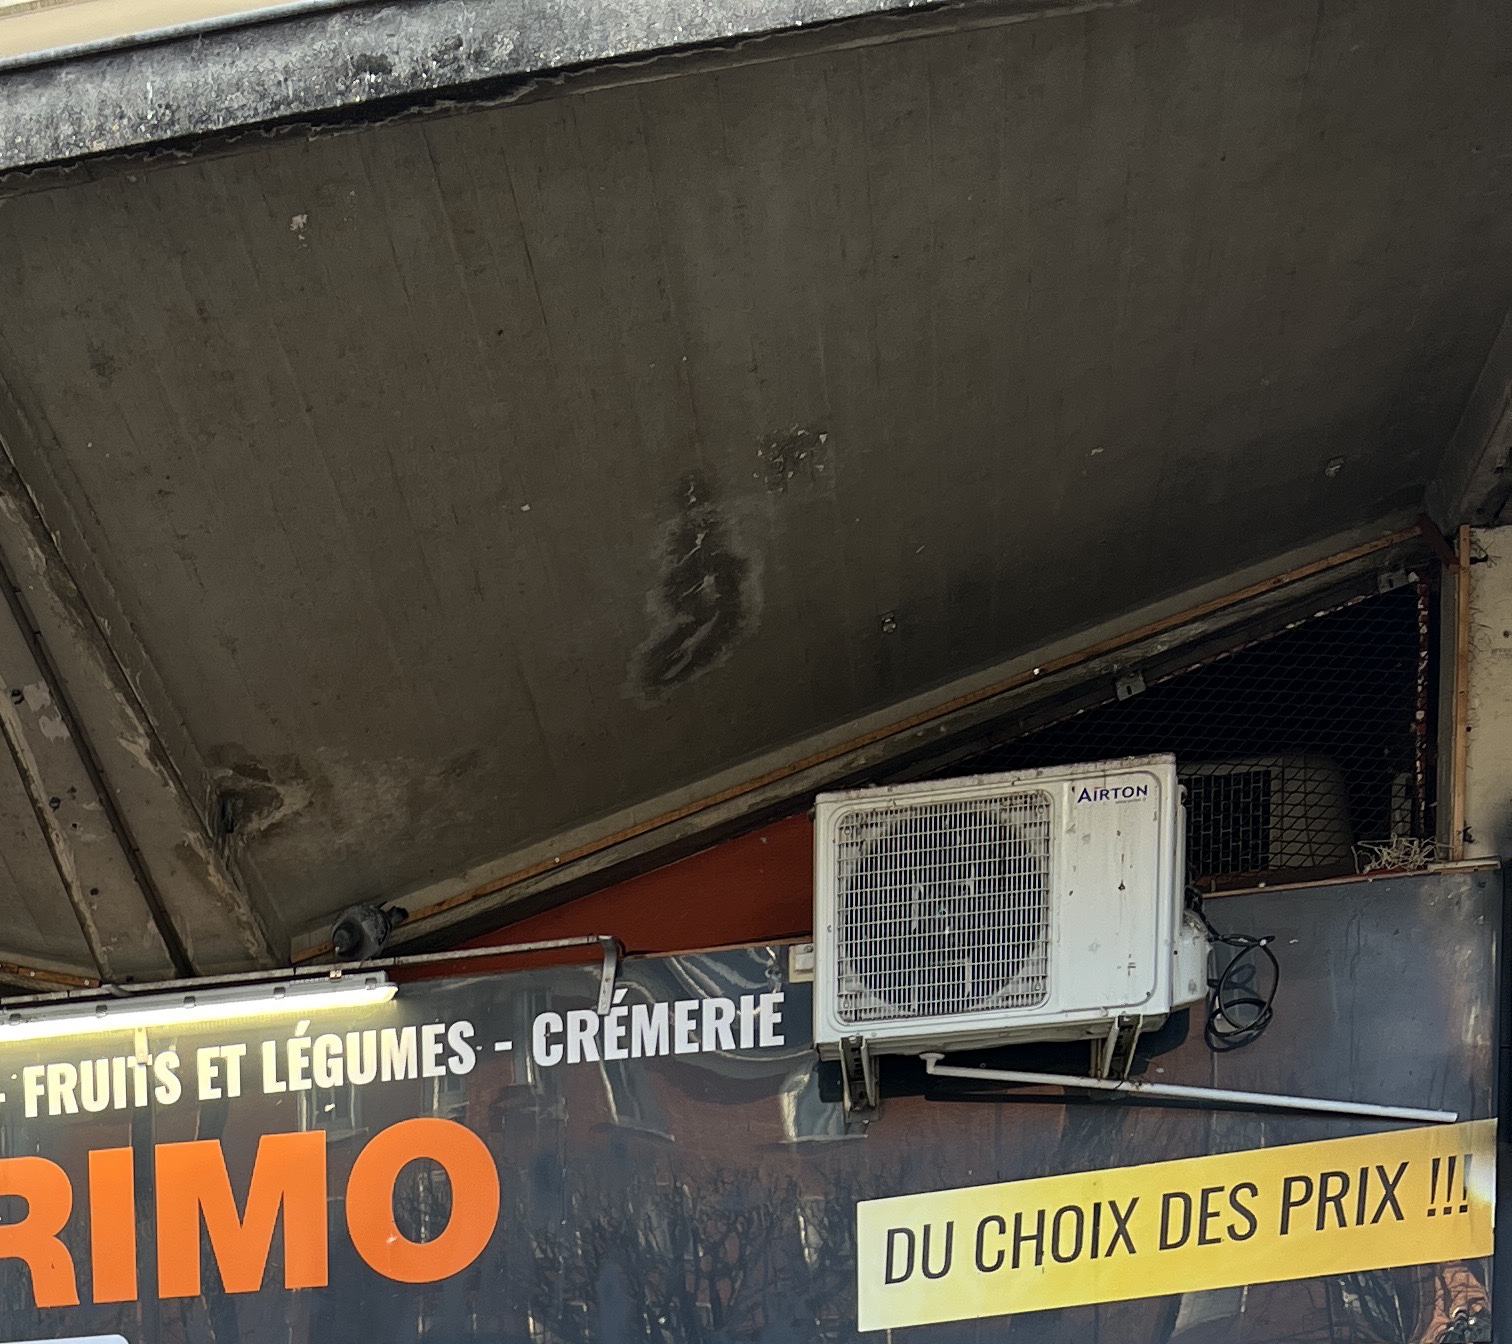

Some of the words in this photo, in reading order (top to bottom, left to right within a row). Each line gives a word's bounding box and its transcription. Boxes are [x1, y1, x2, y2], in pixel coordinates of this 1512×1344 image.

[1077, 784, 1148, 803] AIRTON
[24, 1050, 182, 1118] FRUITS
[197, 1044, 248, 1101] ET
[261, 1020, 477, 1093] LÉGUMES
[532, 988, 785, 1067] CRÉMERIE
[883, 1221, 955, 1286] DU
[974, 1196, 1141, 1274] CHOIX
[1158, 1181, 1259, 1252] DES
[1278, 1160, 1410, 1237] PRIX
[1426, 1152, 1473, 1218] !!!
